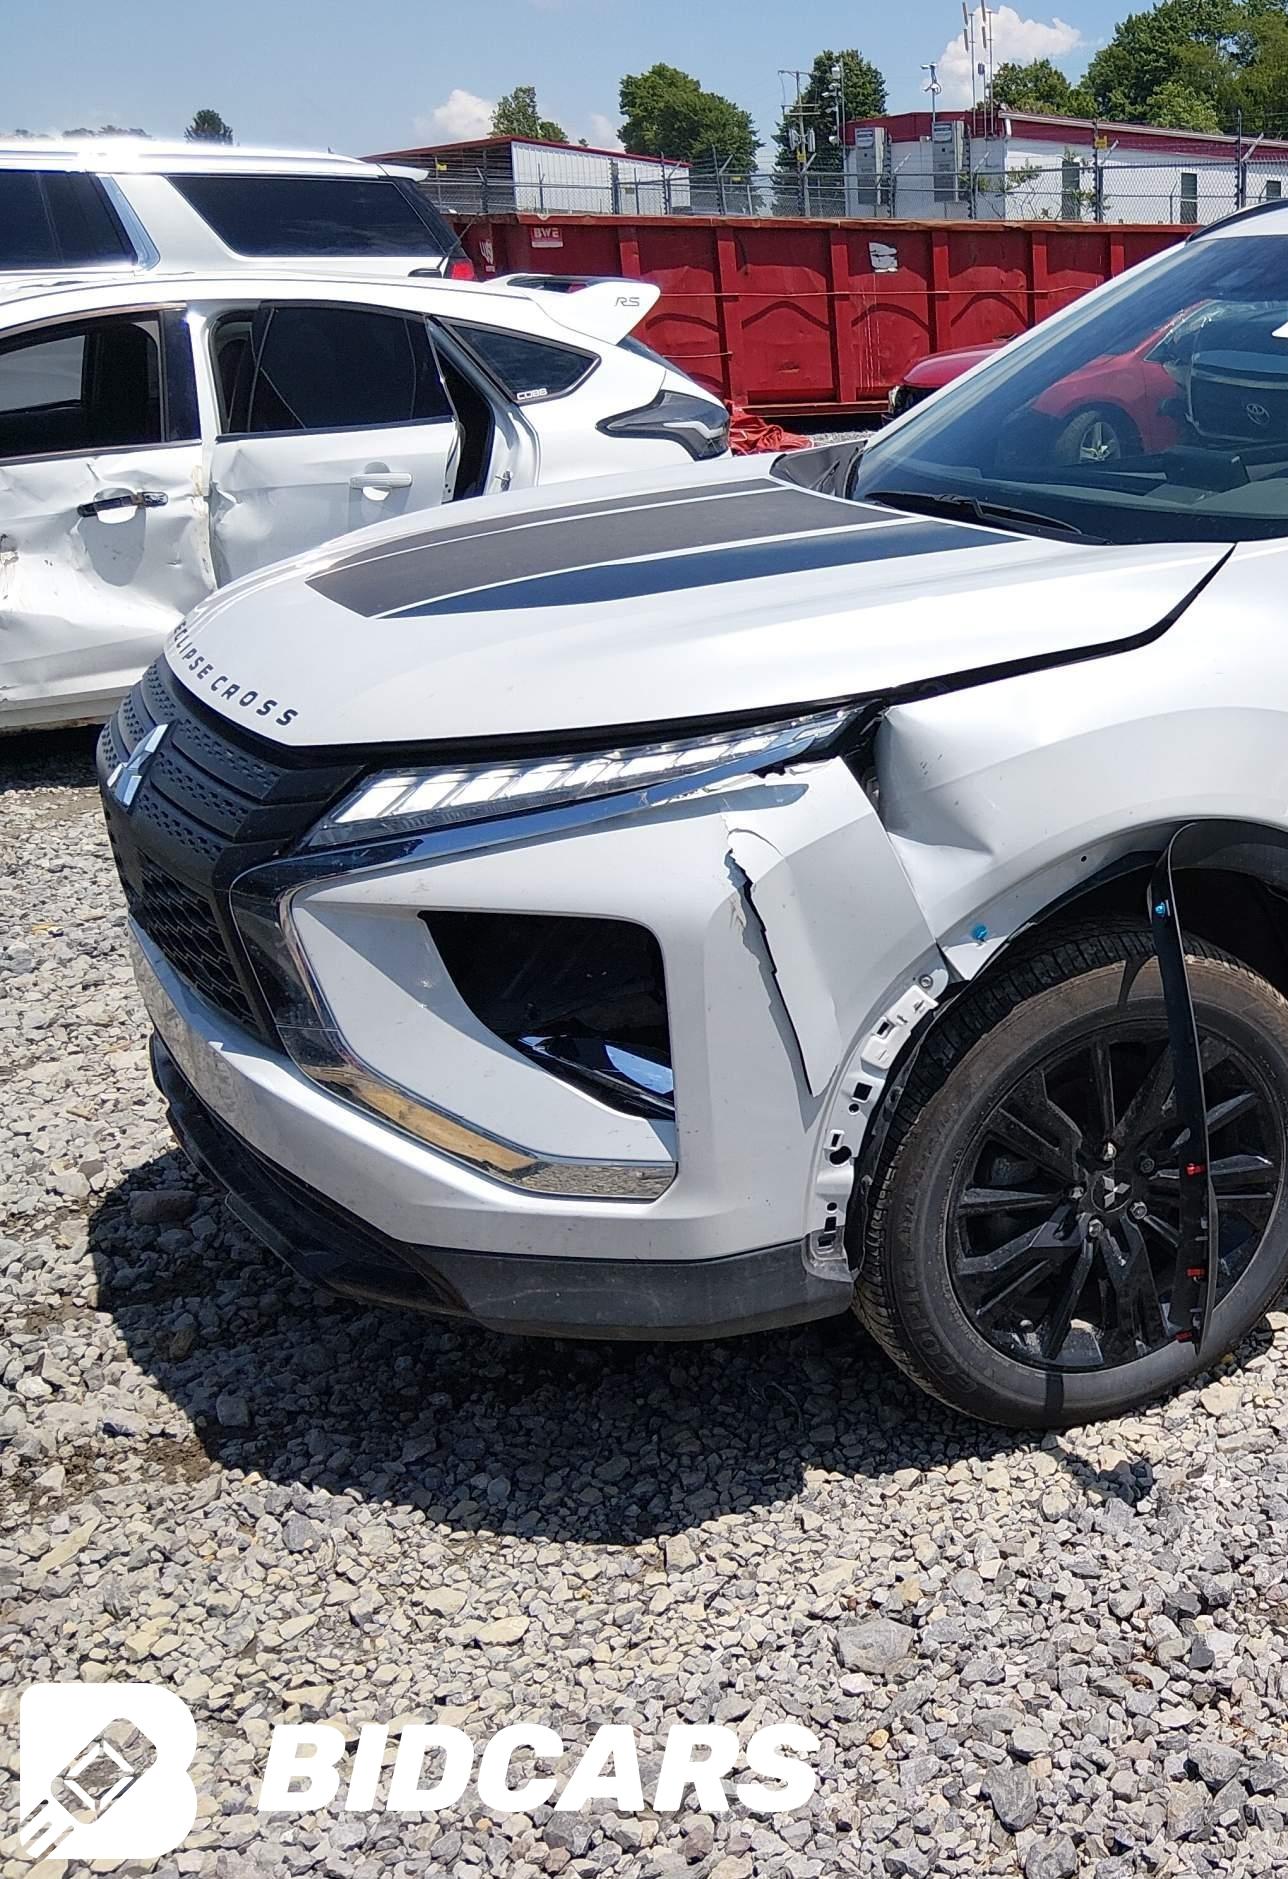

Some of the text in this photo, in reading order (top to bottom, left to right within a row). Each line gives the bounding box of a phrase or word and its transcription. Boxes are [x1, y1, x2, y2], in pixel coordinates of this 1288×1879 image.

[614, 296, 640, 307] RS
[173, 620, 299, 726] ECLIPSE CROSS
